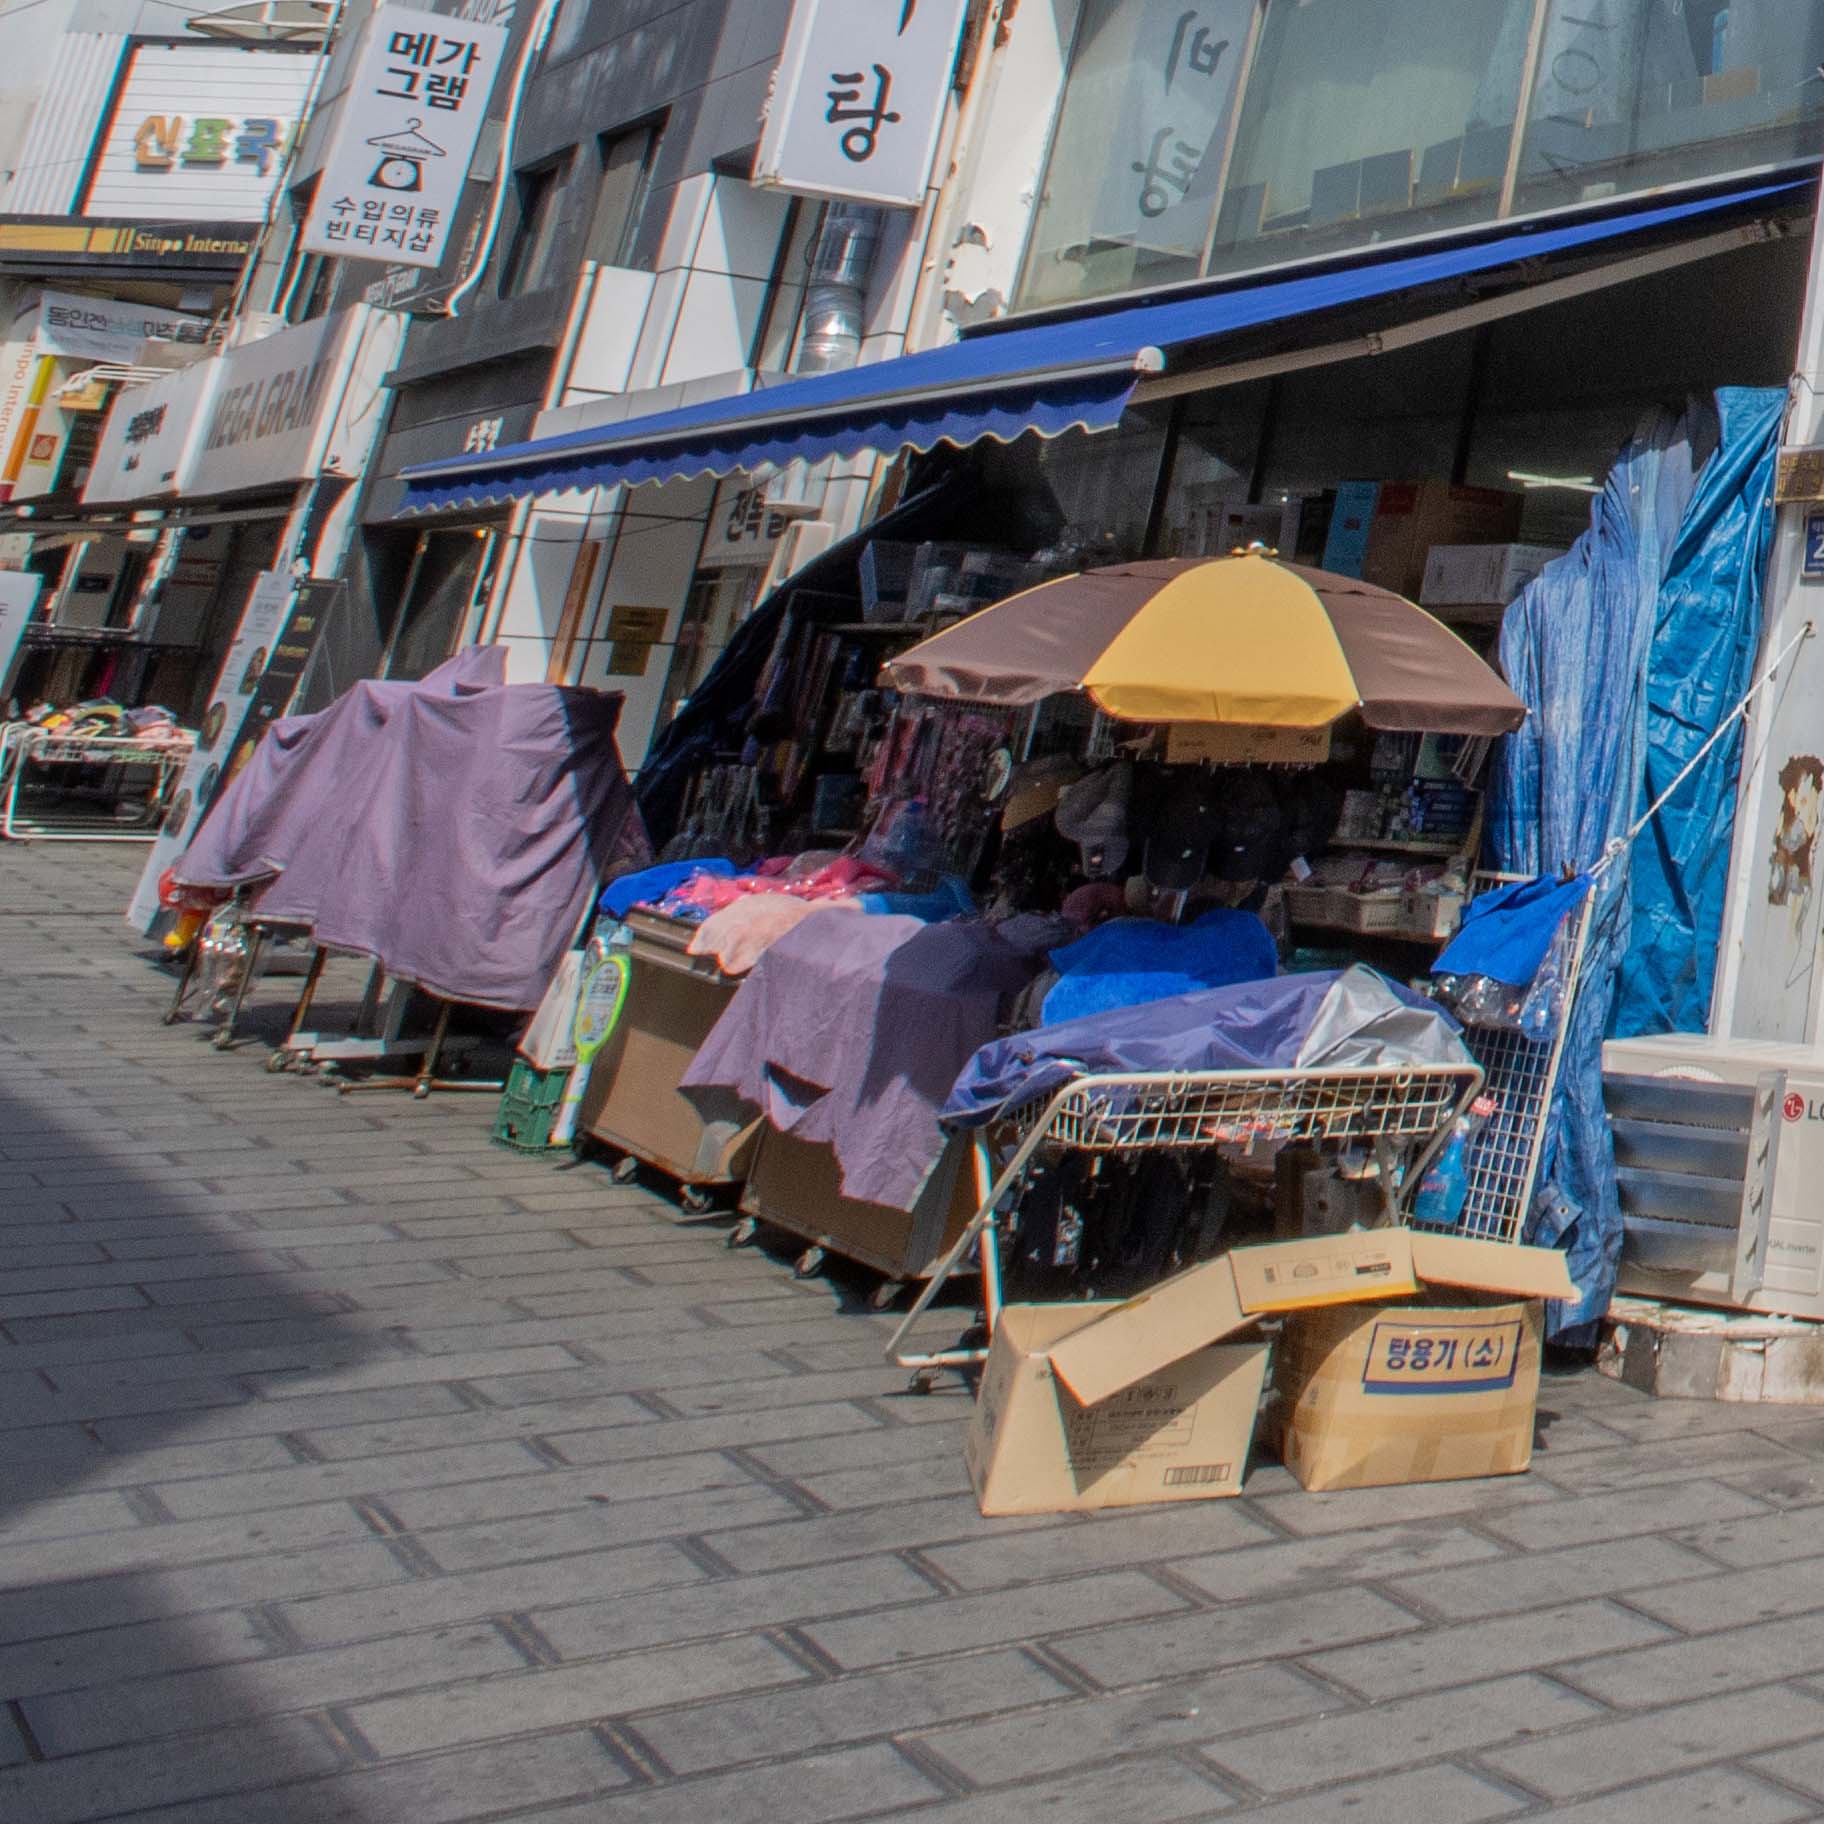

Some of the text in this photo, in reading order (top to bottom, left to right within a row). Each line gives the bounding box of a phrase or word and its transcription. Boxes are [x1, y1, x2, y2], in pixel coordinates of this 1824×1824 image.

[387, 31, 481, 74] 메가
[376, 67, 469, 111] 그램
[332, 195, 440, 228] 수입의류
[134, 233, 185, 255] Sinpo
[1387, 1333, 1505, 1370] 탕용기 (소)
